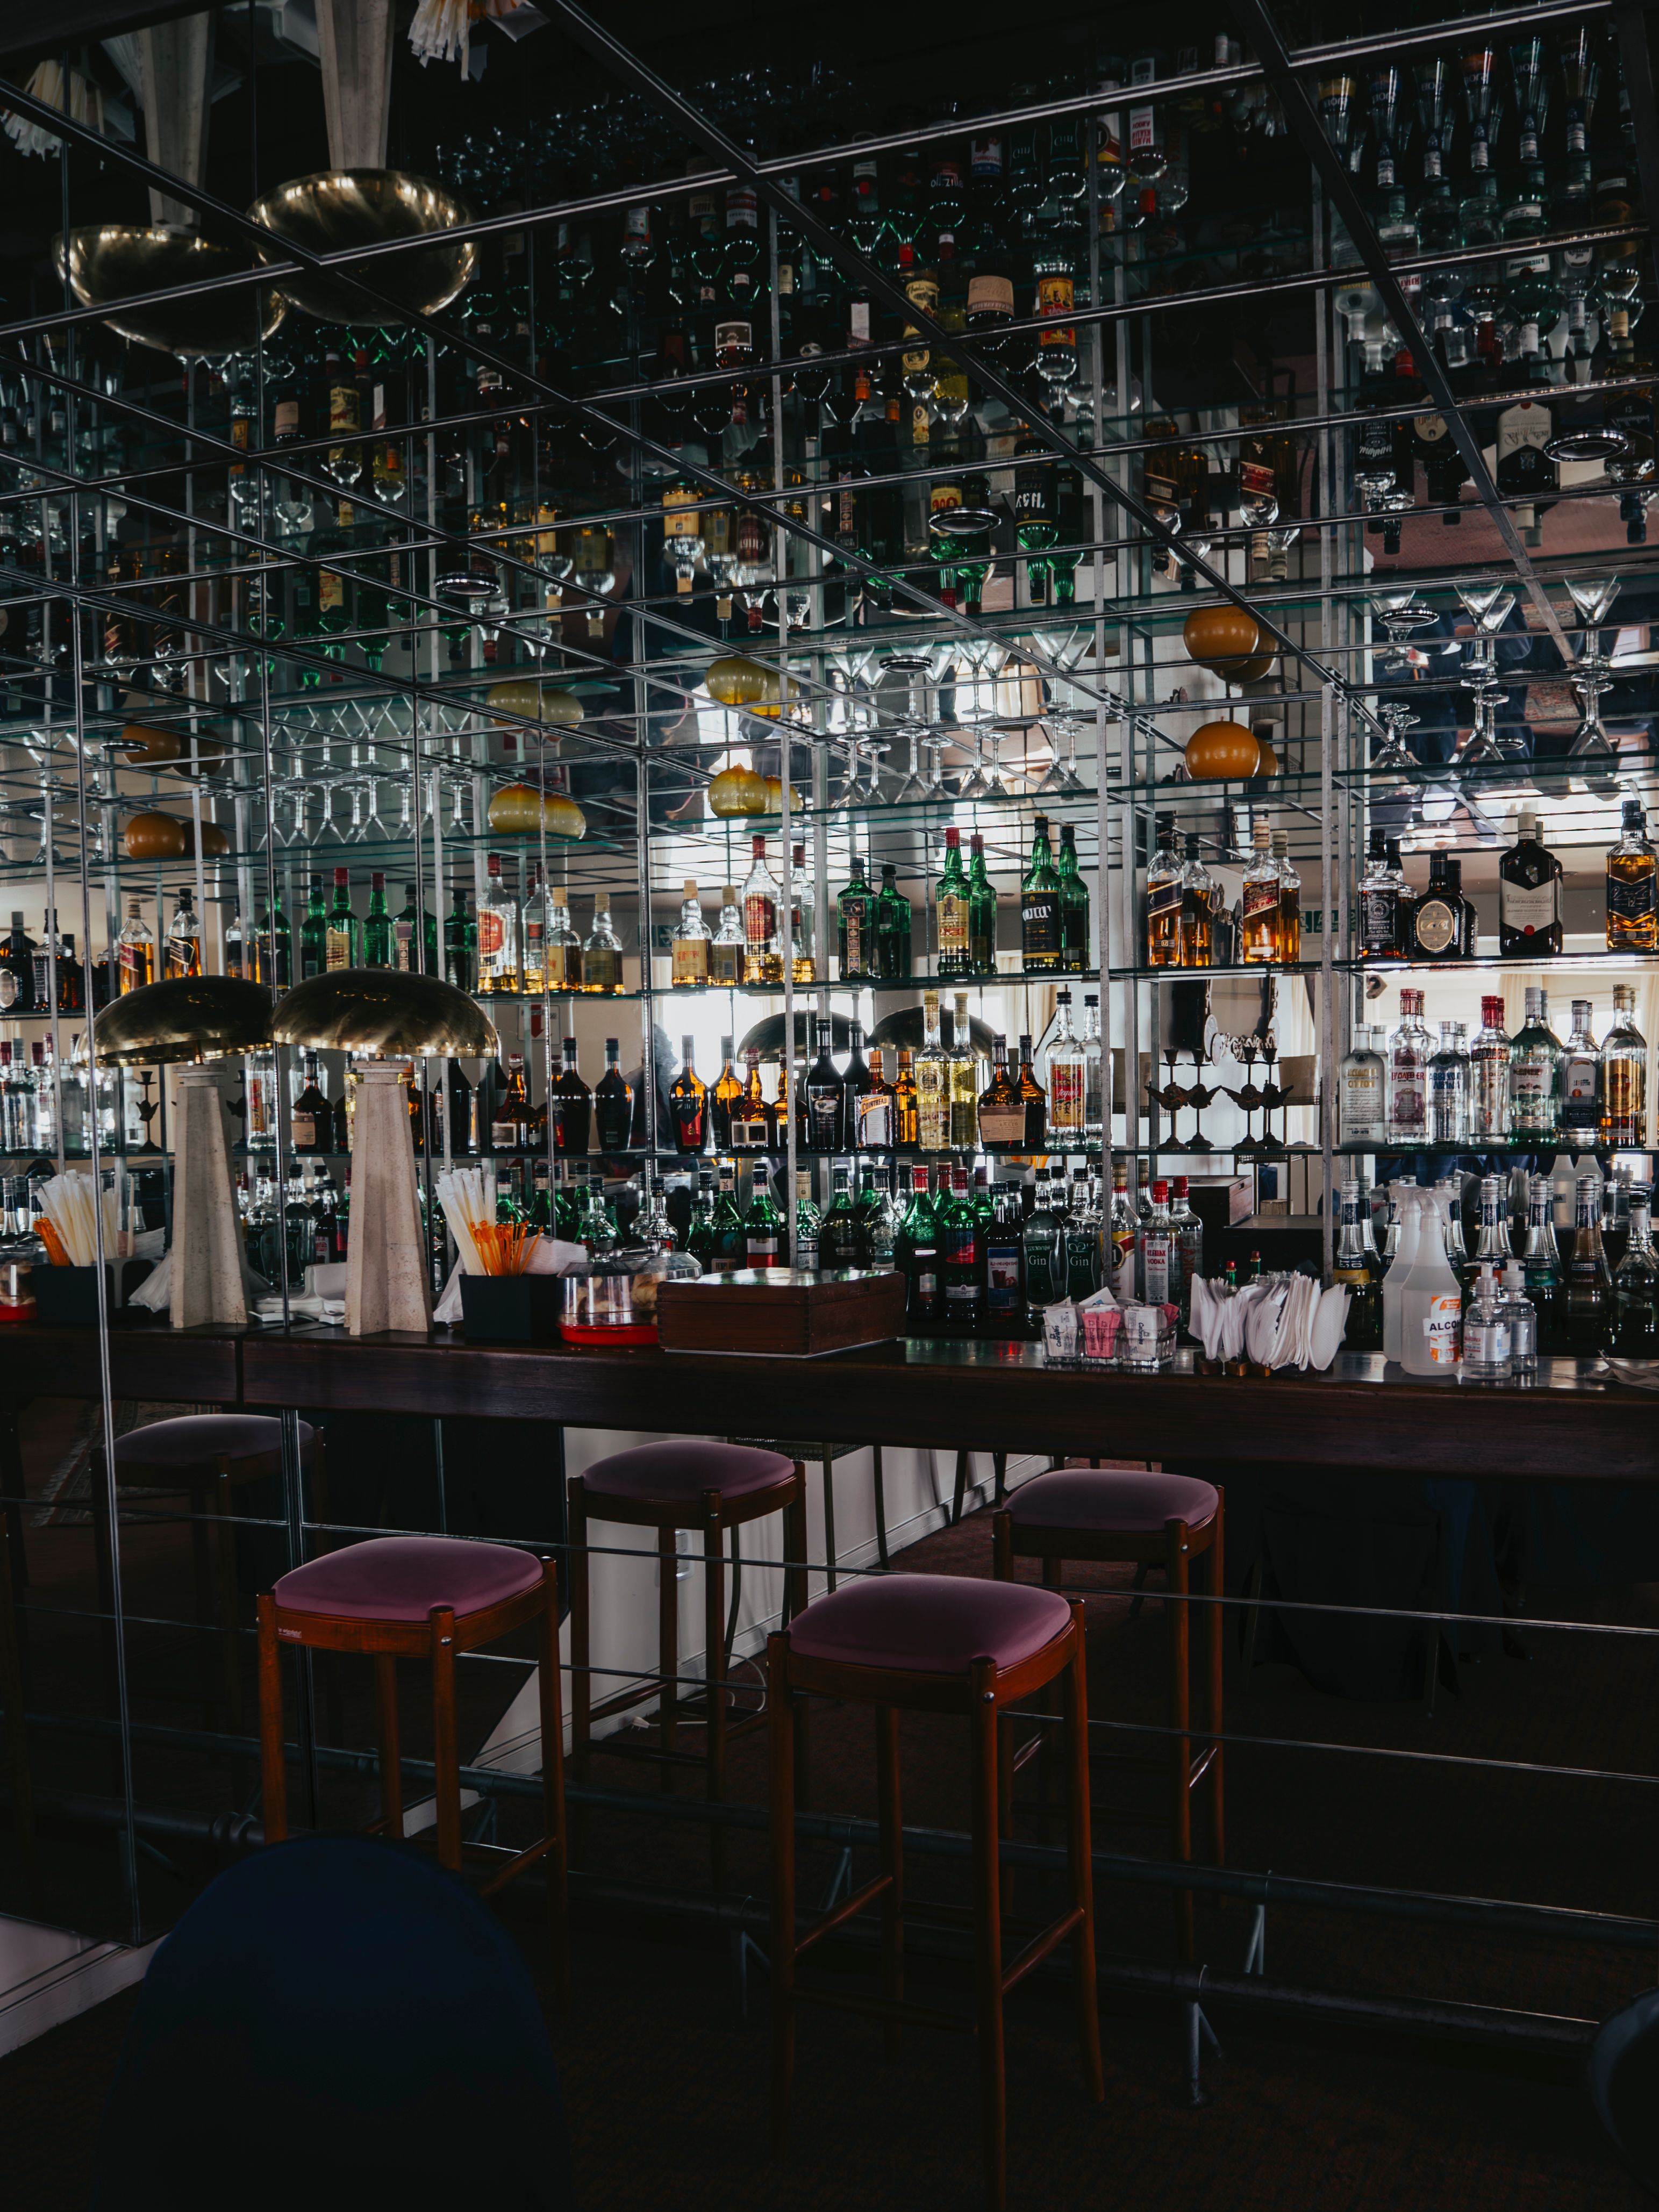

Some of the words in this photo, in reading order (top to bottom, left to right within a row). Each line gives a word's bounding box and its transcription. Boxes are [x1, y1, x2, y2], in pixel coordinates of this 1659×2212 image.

[862, 1098, 887, 1112] COINTREAU
[1028, 1255, 1046, 1266] Gin
[1070, 1256, 1089, 1266] Gin
